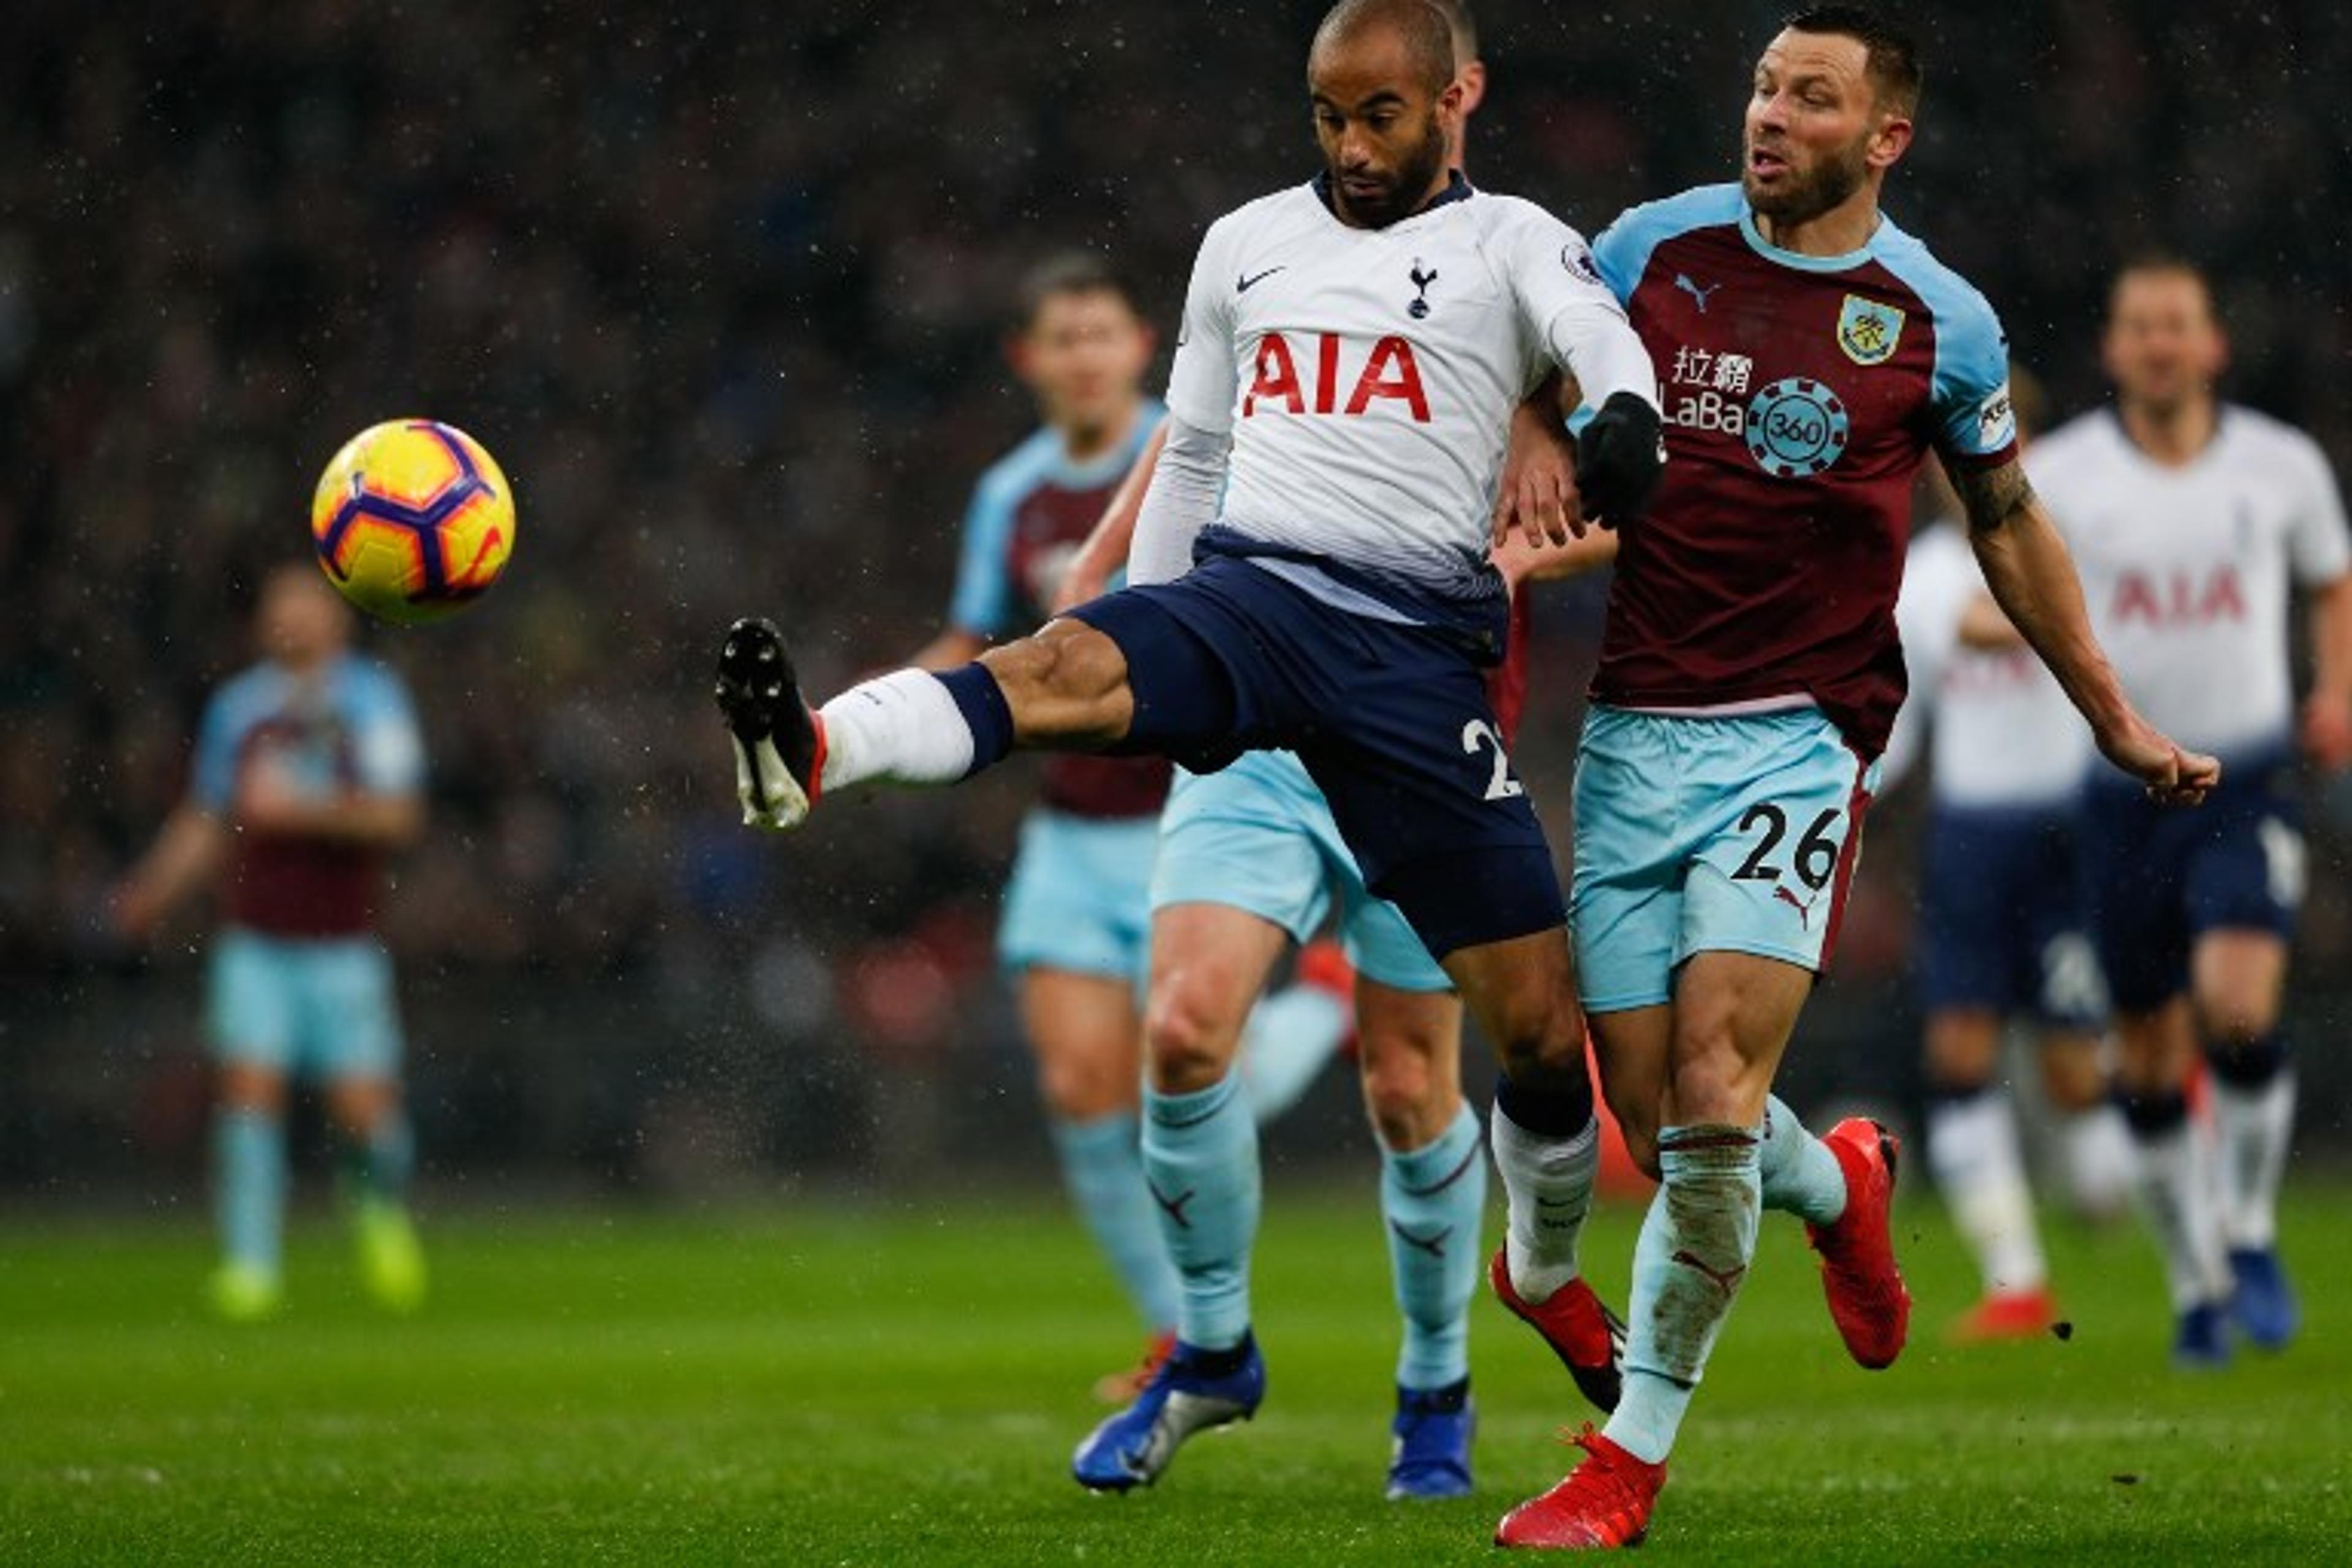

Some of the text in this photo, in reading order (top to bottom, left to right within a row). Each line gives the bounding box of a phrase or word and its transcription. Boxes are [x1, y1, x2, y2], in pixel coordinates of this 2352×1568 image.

[1243, 331, 1431, 423] AIA
[1659, 382, 1822, 445] LaBa 360
[2109, 564, 2252, 628] AIA
[1463, 719, 1523, 800] 2
[1730, 804, 1841, 891] 26
